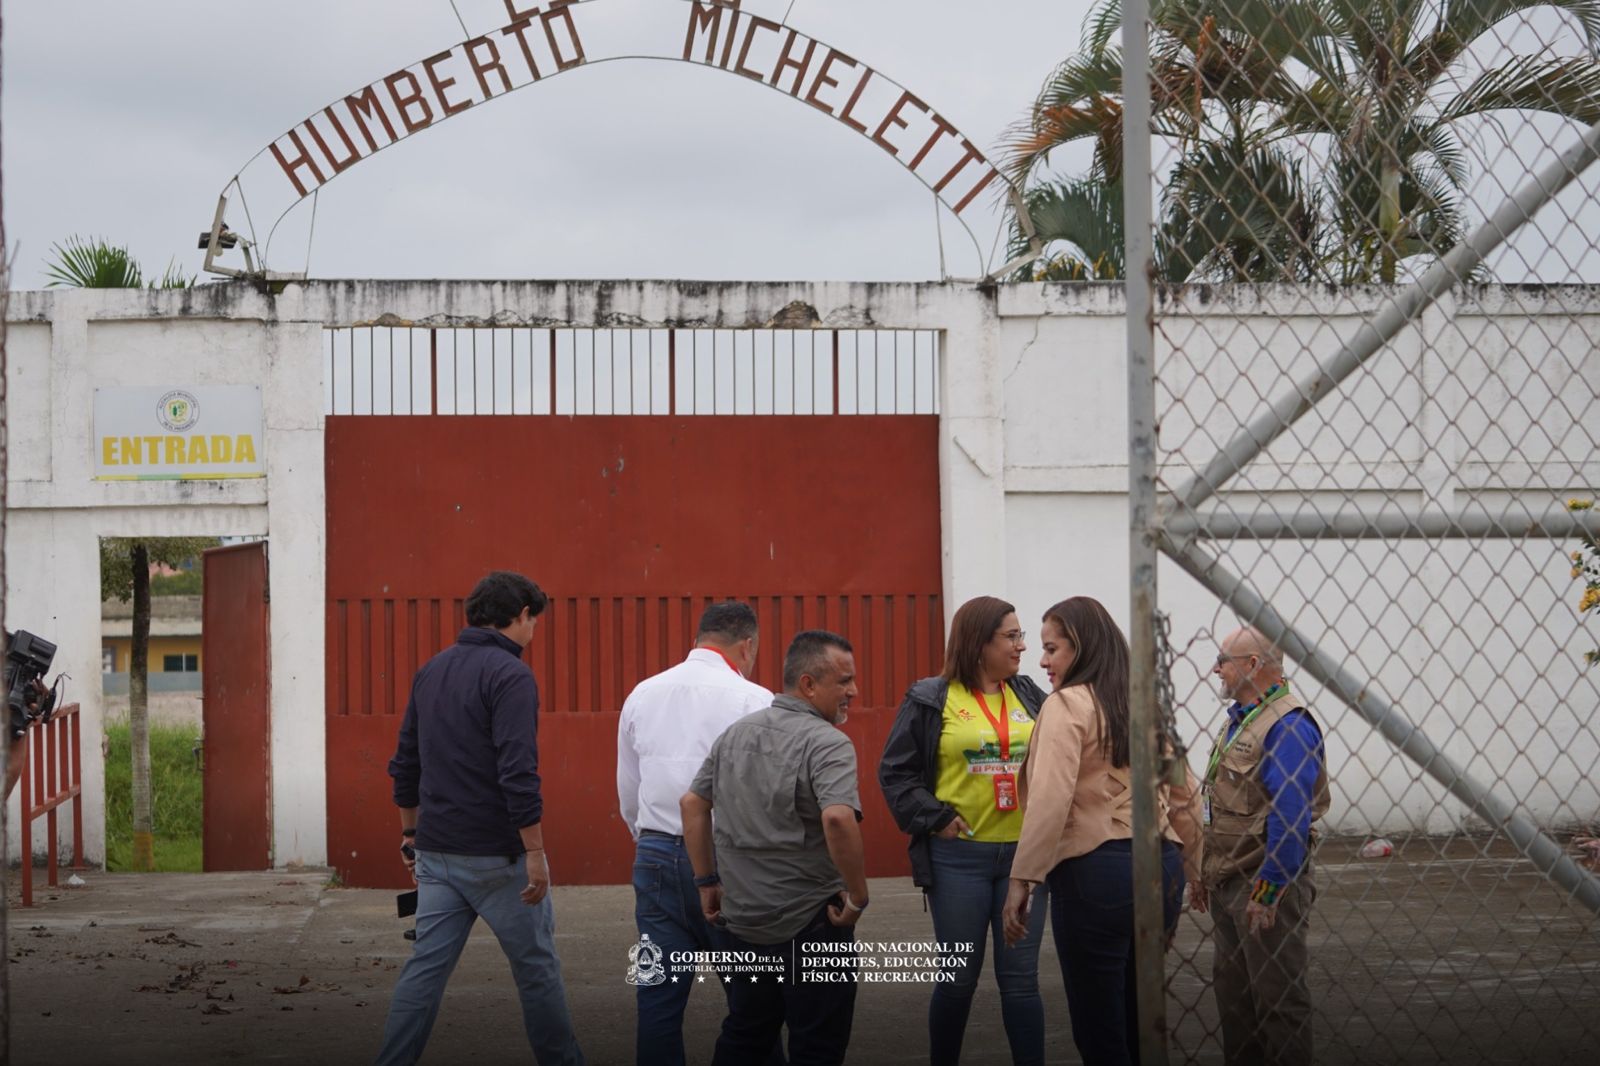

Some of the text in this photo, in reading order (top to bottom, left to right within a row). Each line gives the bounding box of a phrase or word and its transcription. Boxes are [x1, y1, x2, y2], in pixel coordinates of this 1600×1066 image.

[268, 2, 1000, 215] HUMBERTO MICHELETTI
[102, 434, 257, 466] ENTRADA
